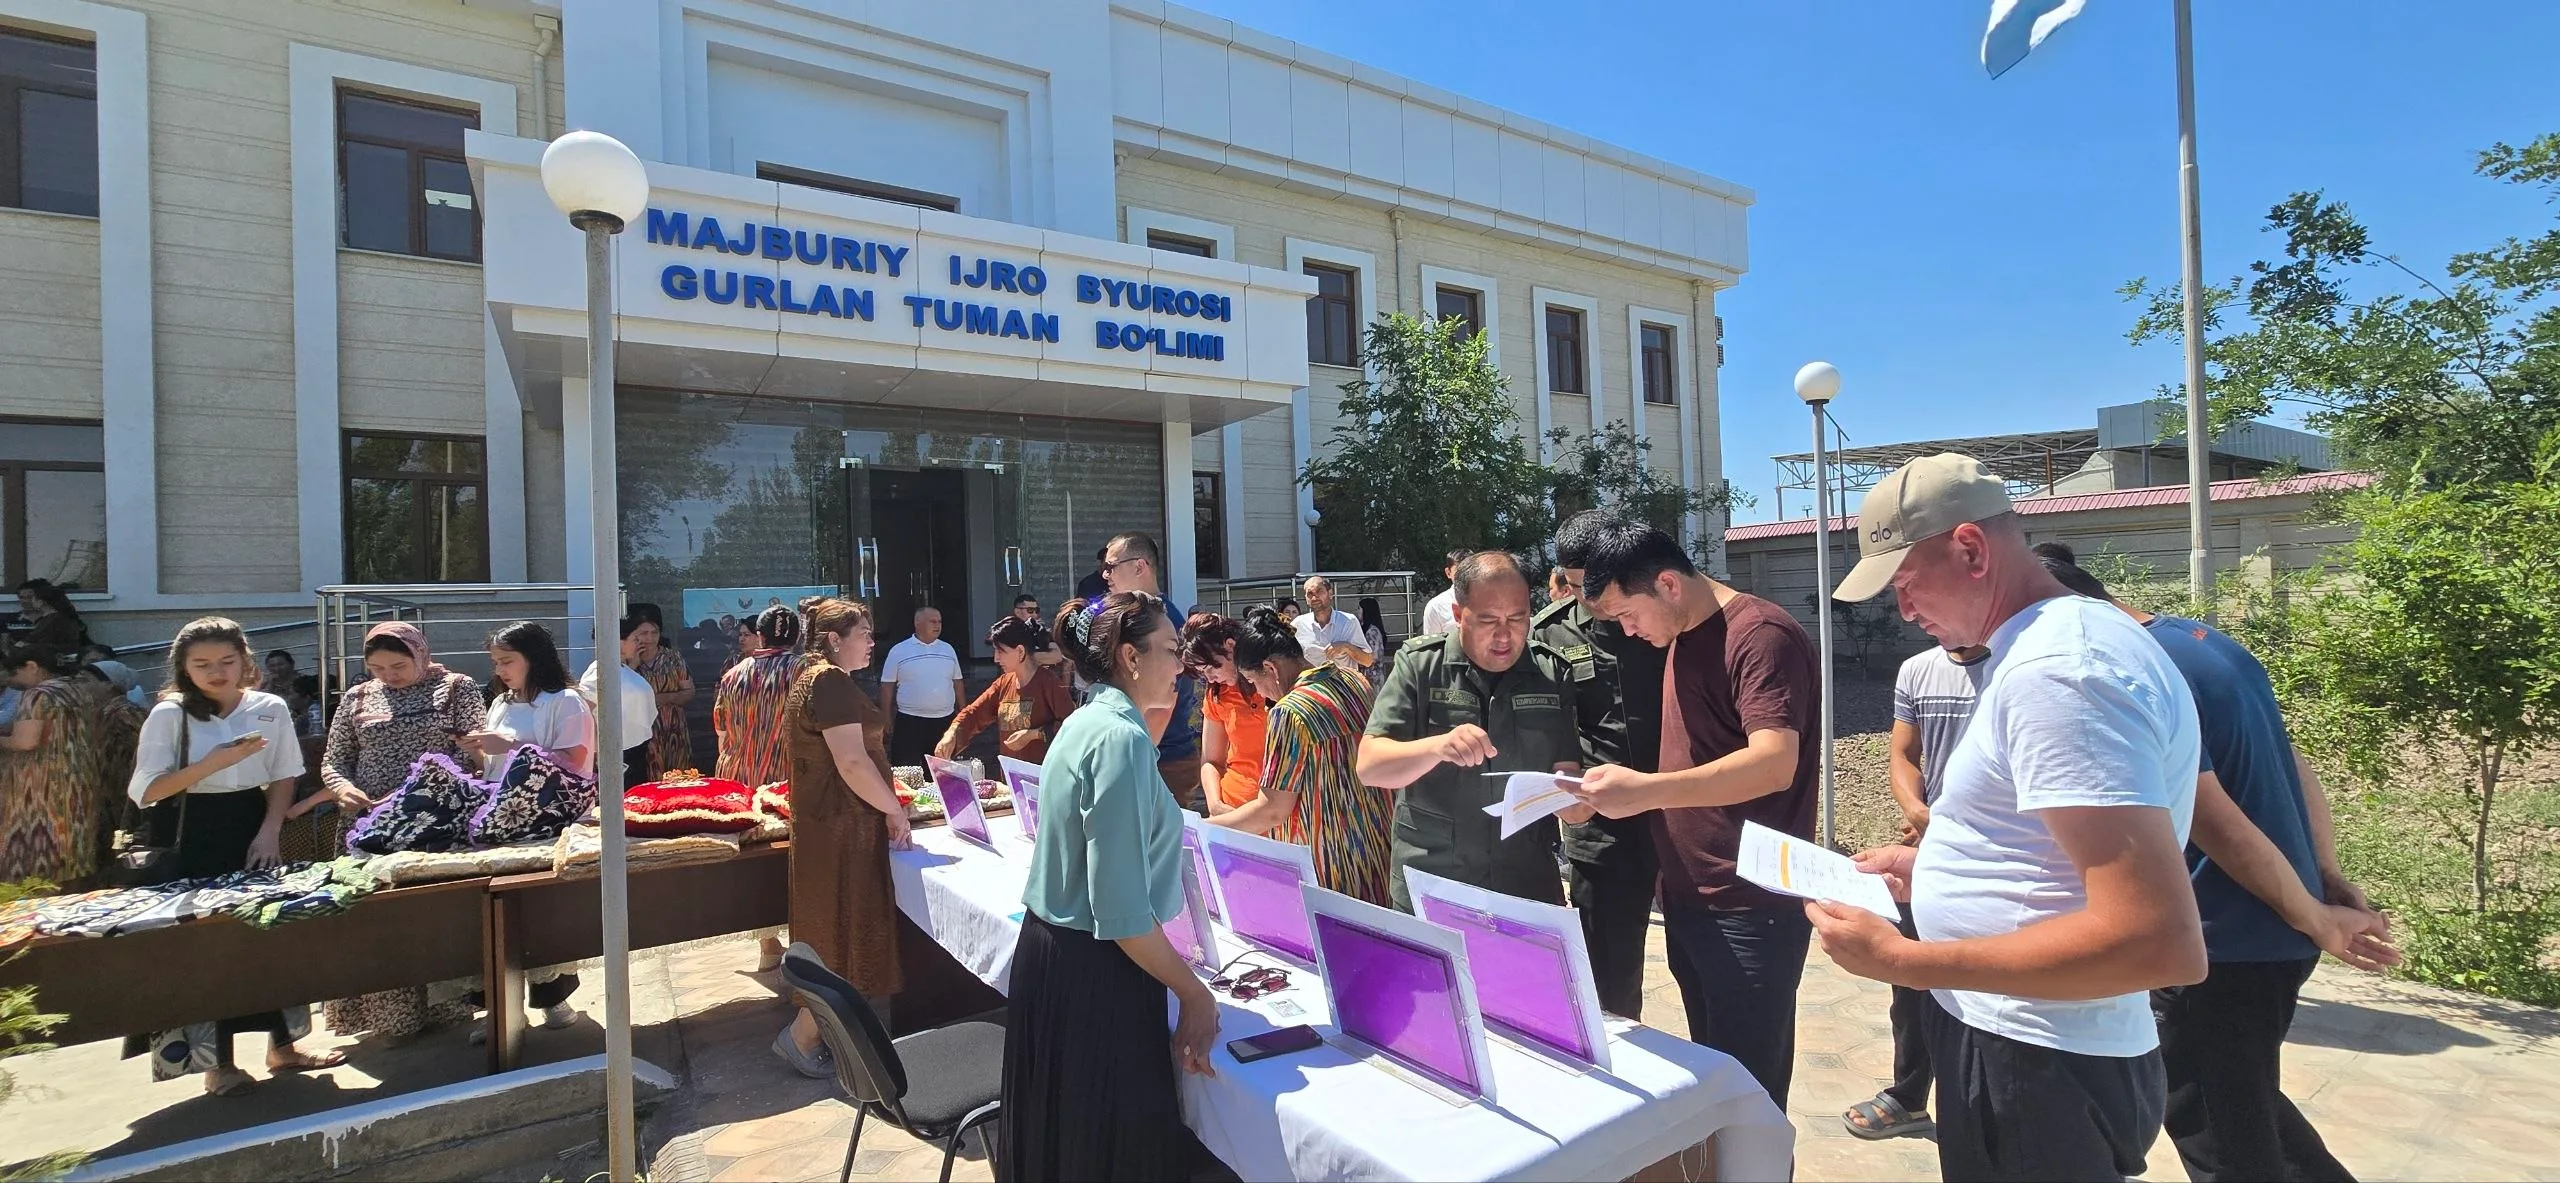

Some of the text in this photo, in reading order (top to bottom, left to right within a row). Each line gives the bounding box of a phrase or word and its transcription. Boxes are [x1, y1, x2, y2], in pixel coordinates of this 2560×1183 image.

[647, 208, 1231, 323] MAJBURIY IJRO BYUROSI
[660, 265, 875, 322] GURLAN
[903, 295, 1060, 343] TUMAN
[1870, 522, 1892, 543] alo
